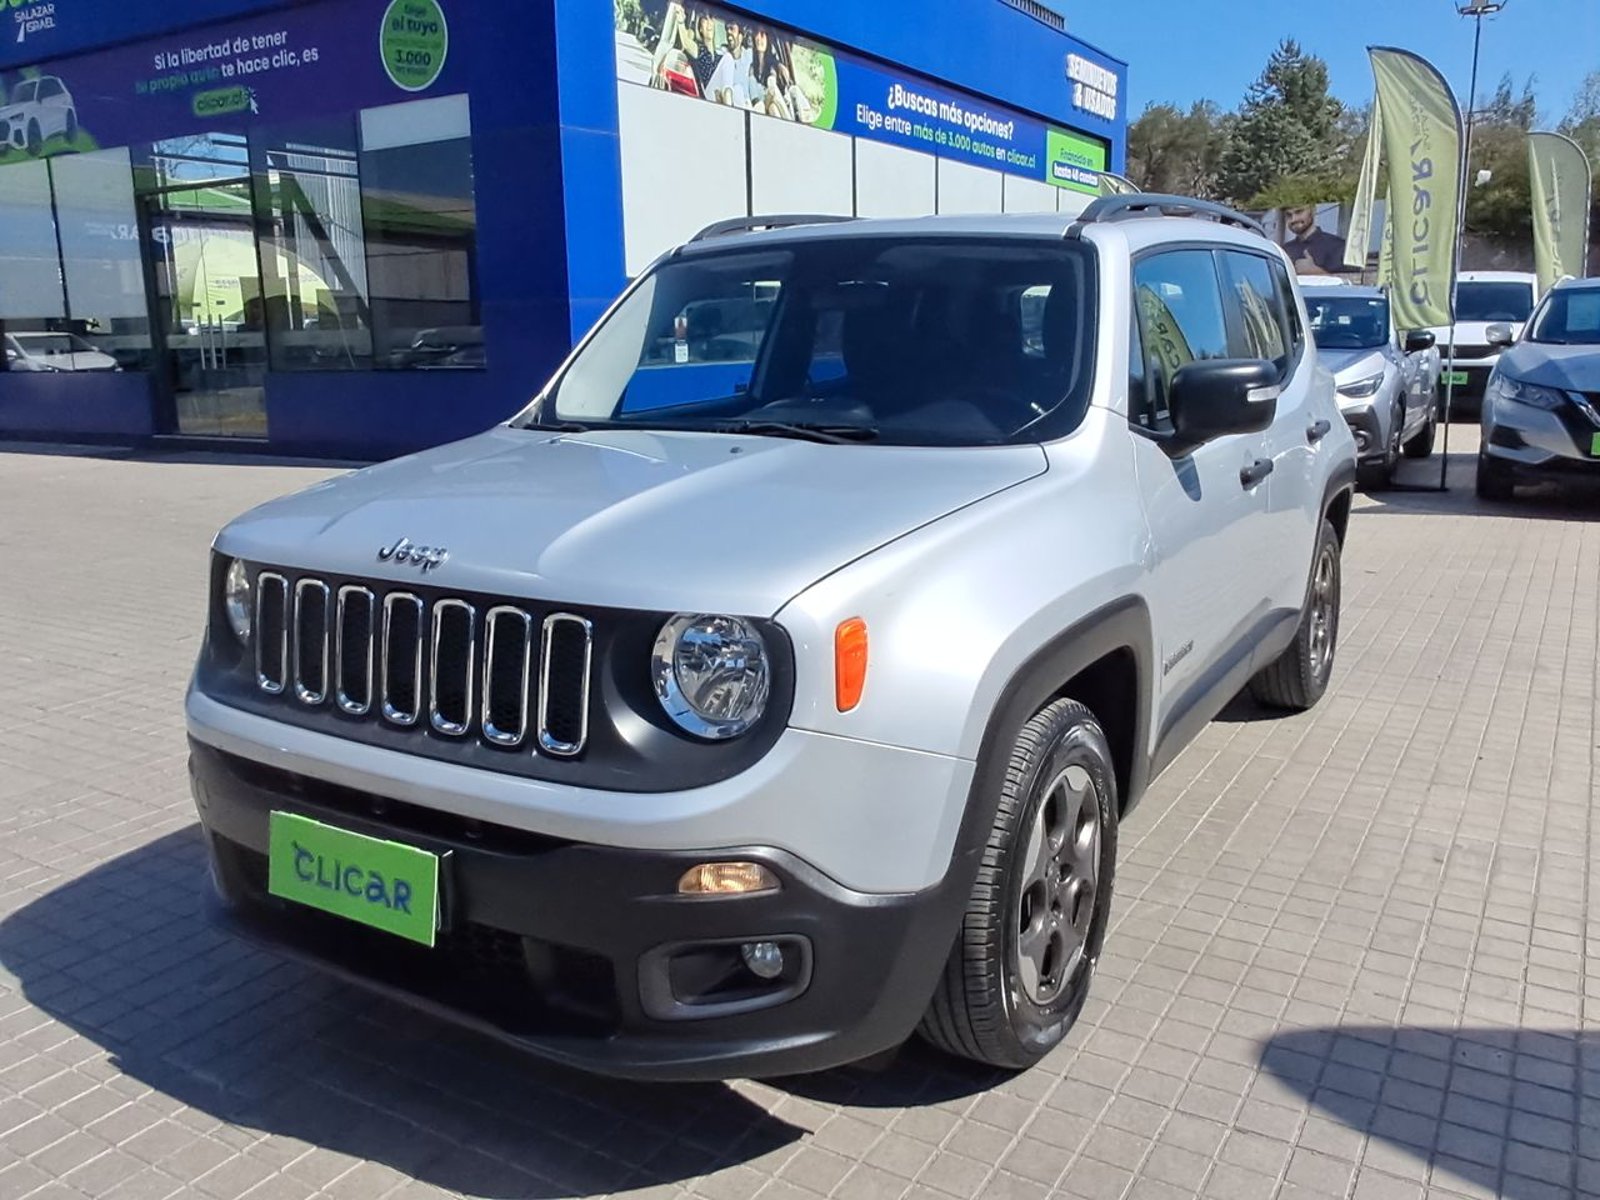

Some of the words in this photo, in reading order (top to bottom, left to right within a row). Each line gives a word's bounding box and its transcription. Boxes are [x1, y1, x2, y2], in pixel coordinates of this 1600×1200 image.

[14, 3, 55, 23] SALAZAR
[407, 18, 438, 36] tuyo
[154, 52, 166, 70] Si
[167, 52, 180, 67] la
[180, 39, 231, 65] libertad
[233, 37, 250, 54] de
[252, 31, 288, 49] tener
[221, 63, 235, 77] te
[237, 57, 270, 75] hace
[272, 49, 301, 67] clic,
[302, 47, 319, 62] es
[887, 83, 938, 117] ¿Buscas
[939, 101, 962, 125] más
[964, 112, 1014, 141] opciones?
[856, 103, 883, 130] Elige
[884, 115, 912, 136] entre
[913, 122, 933, 141] más
[934, 127, 947, 145] de
[948, 131, 971, 151] 3.000
[972, 140, 996, 158] autos
[996, 147, 1006, 161] en
[377, 537, 449, 572] Jeep
